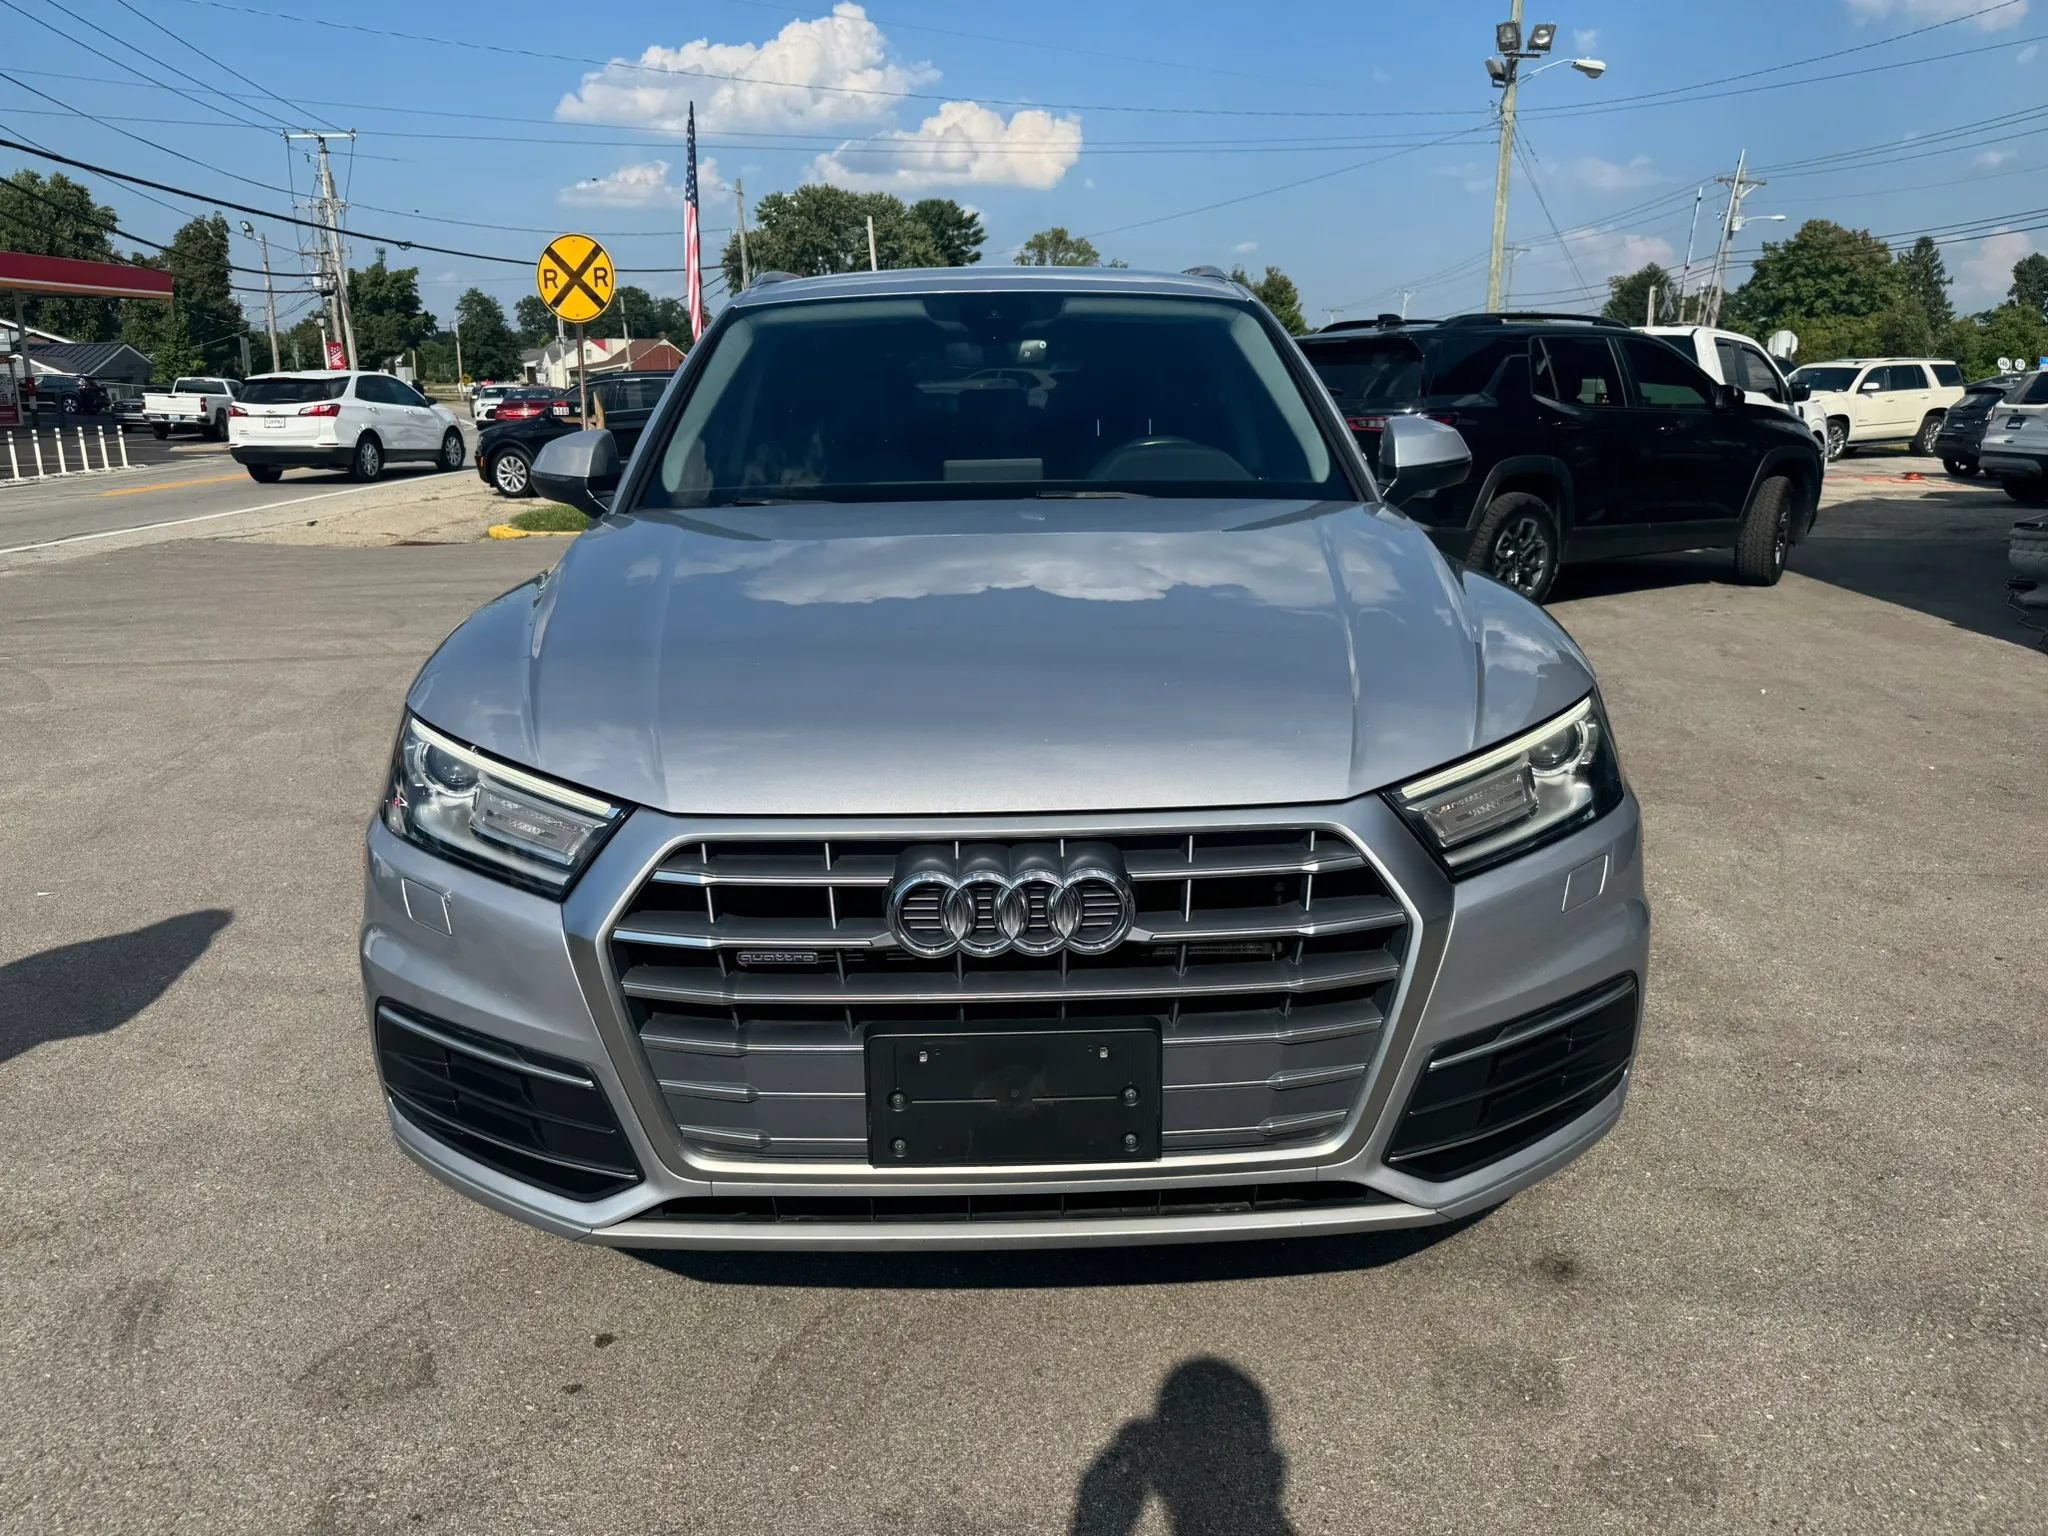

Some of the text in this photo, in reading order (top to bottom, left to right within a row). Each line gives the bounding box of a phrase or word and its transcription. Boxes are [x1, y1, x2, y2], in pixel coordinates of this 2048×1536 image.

[543, 266, 608, 289] R R
[2016, 360, 2024, 369] 22
[740, 953, 815, 963] quattro
